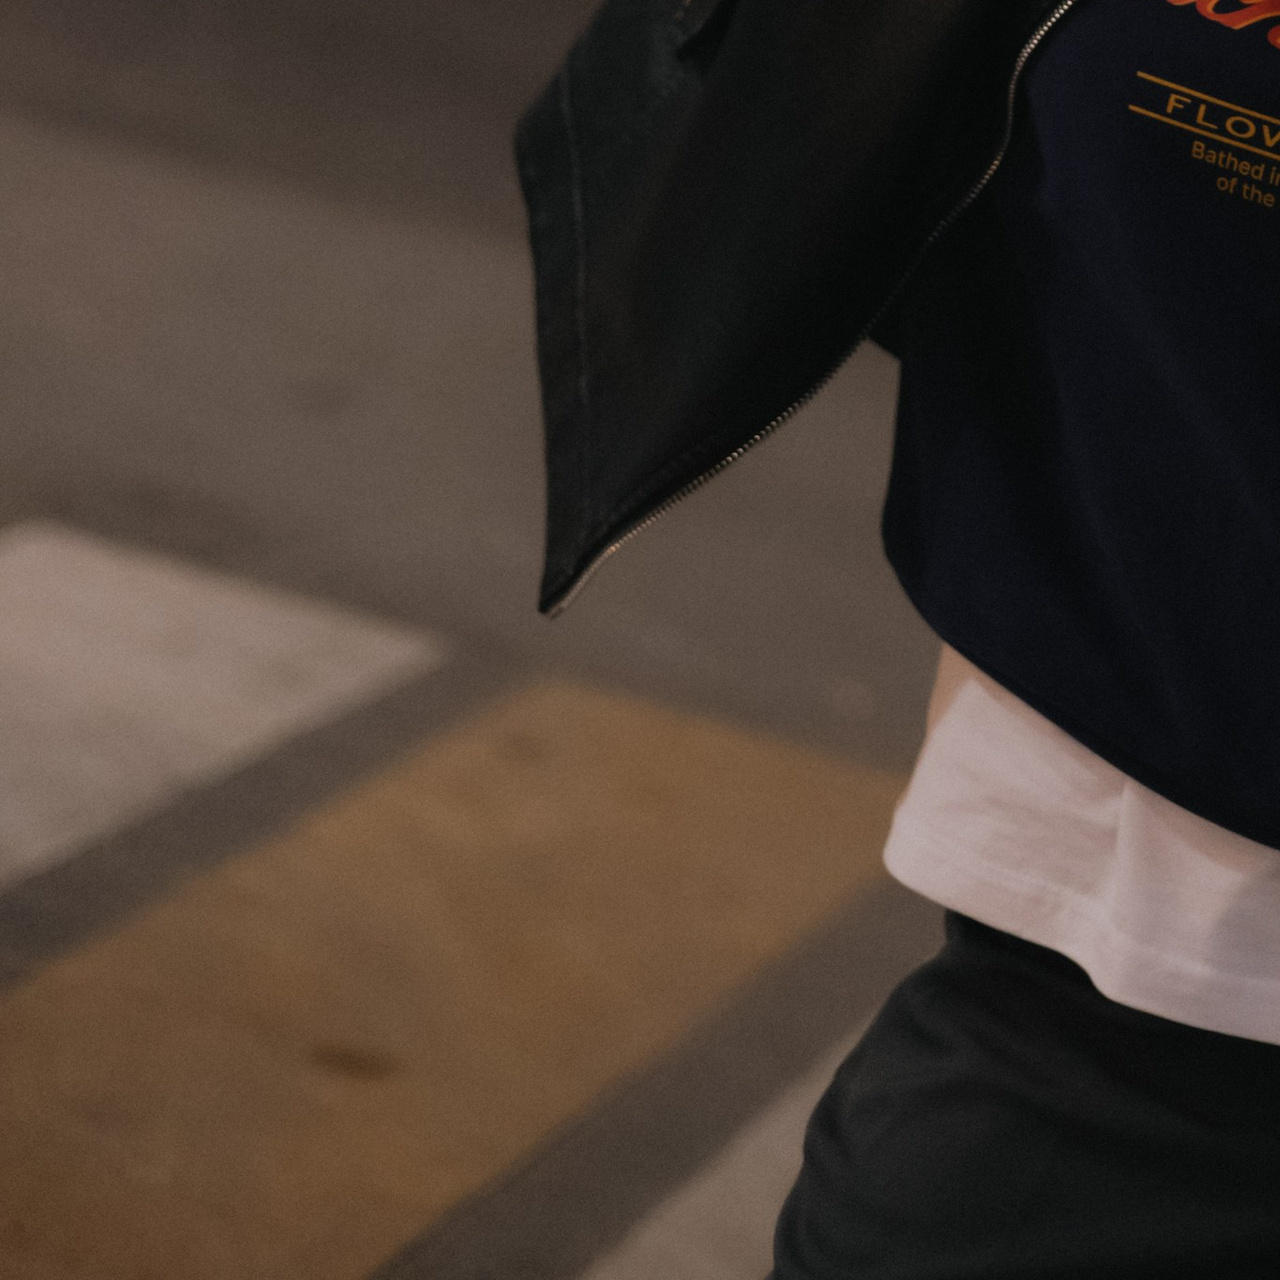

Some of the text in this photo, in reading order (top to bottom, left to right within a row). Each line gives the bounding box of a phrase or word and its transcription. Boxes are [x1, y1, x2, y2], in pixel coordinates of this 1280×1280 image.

[1191, 140, 1266, 181] Bathed
[1216, 176, 1239, 194] of
[1242, 183, 1276, 208] the
